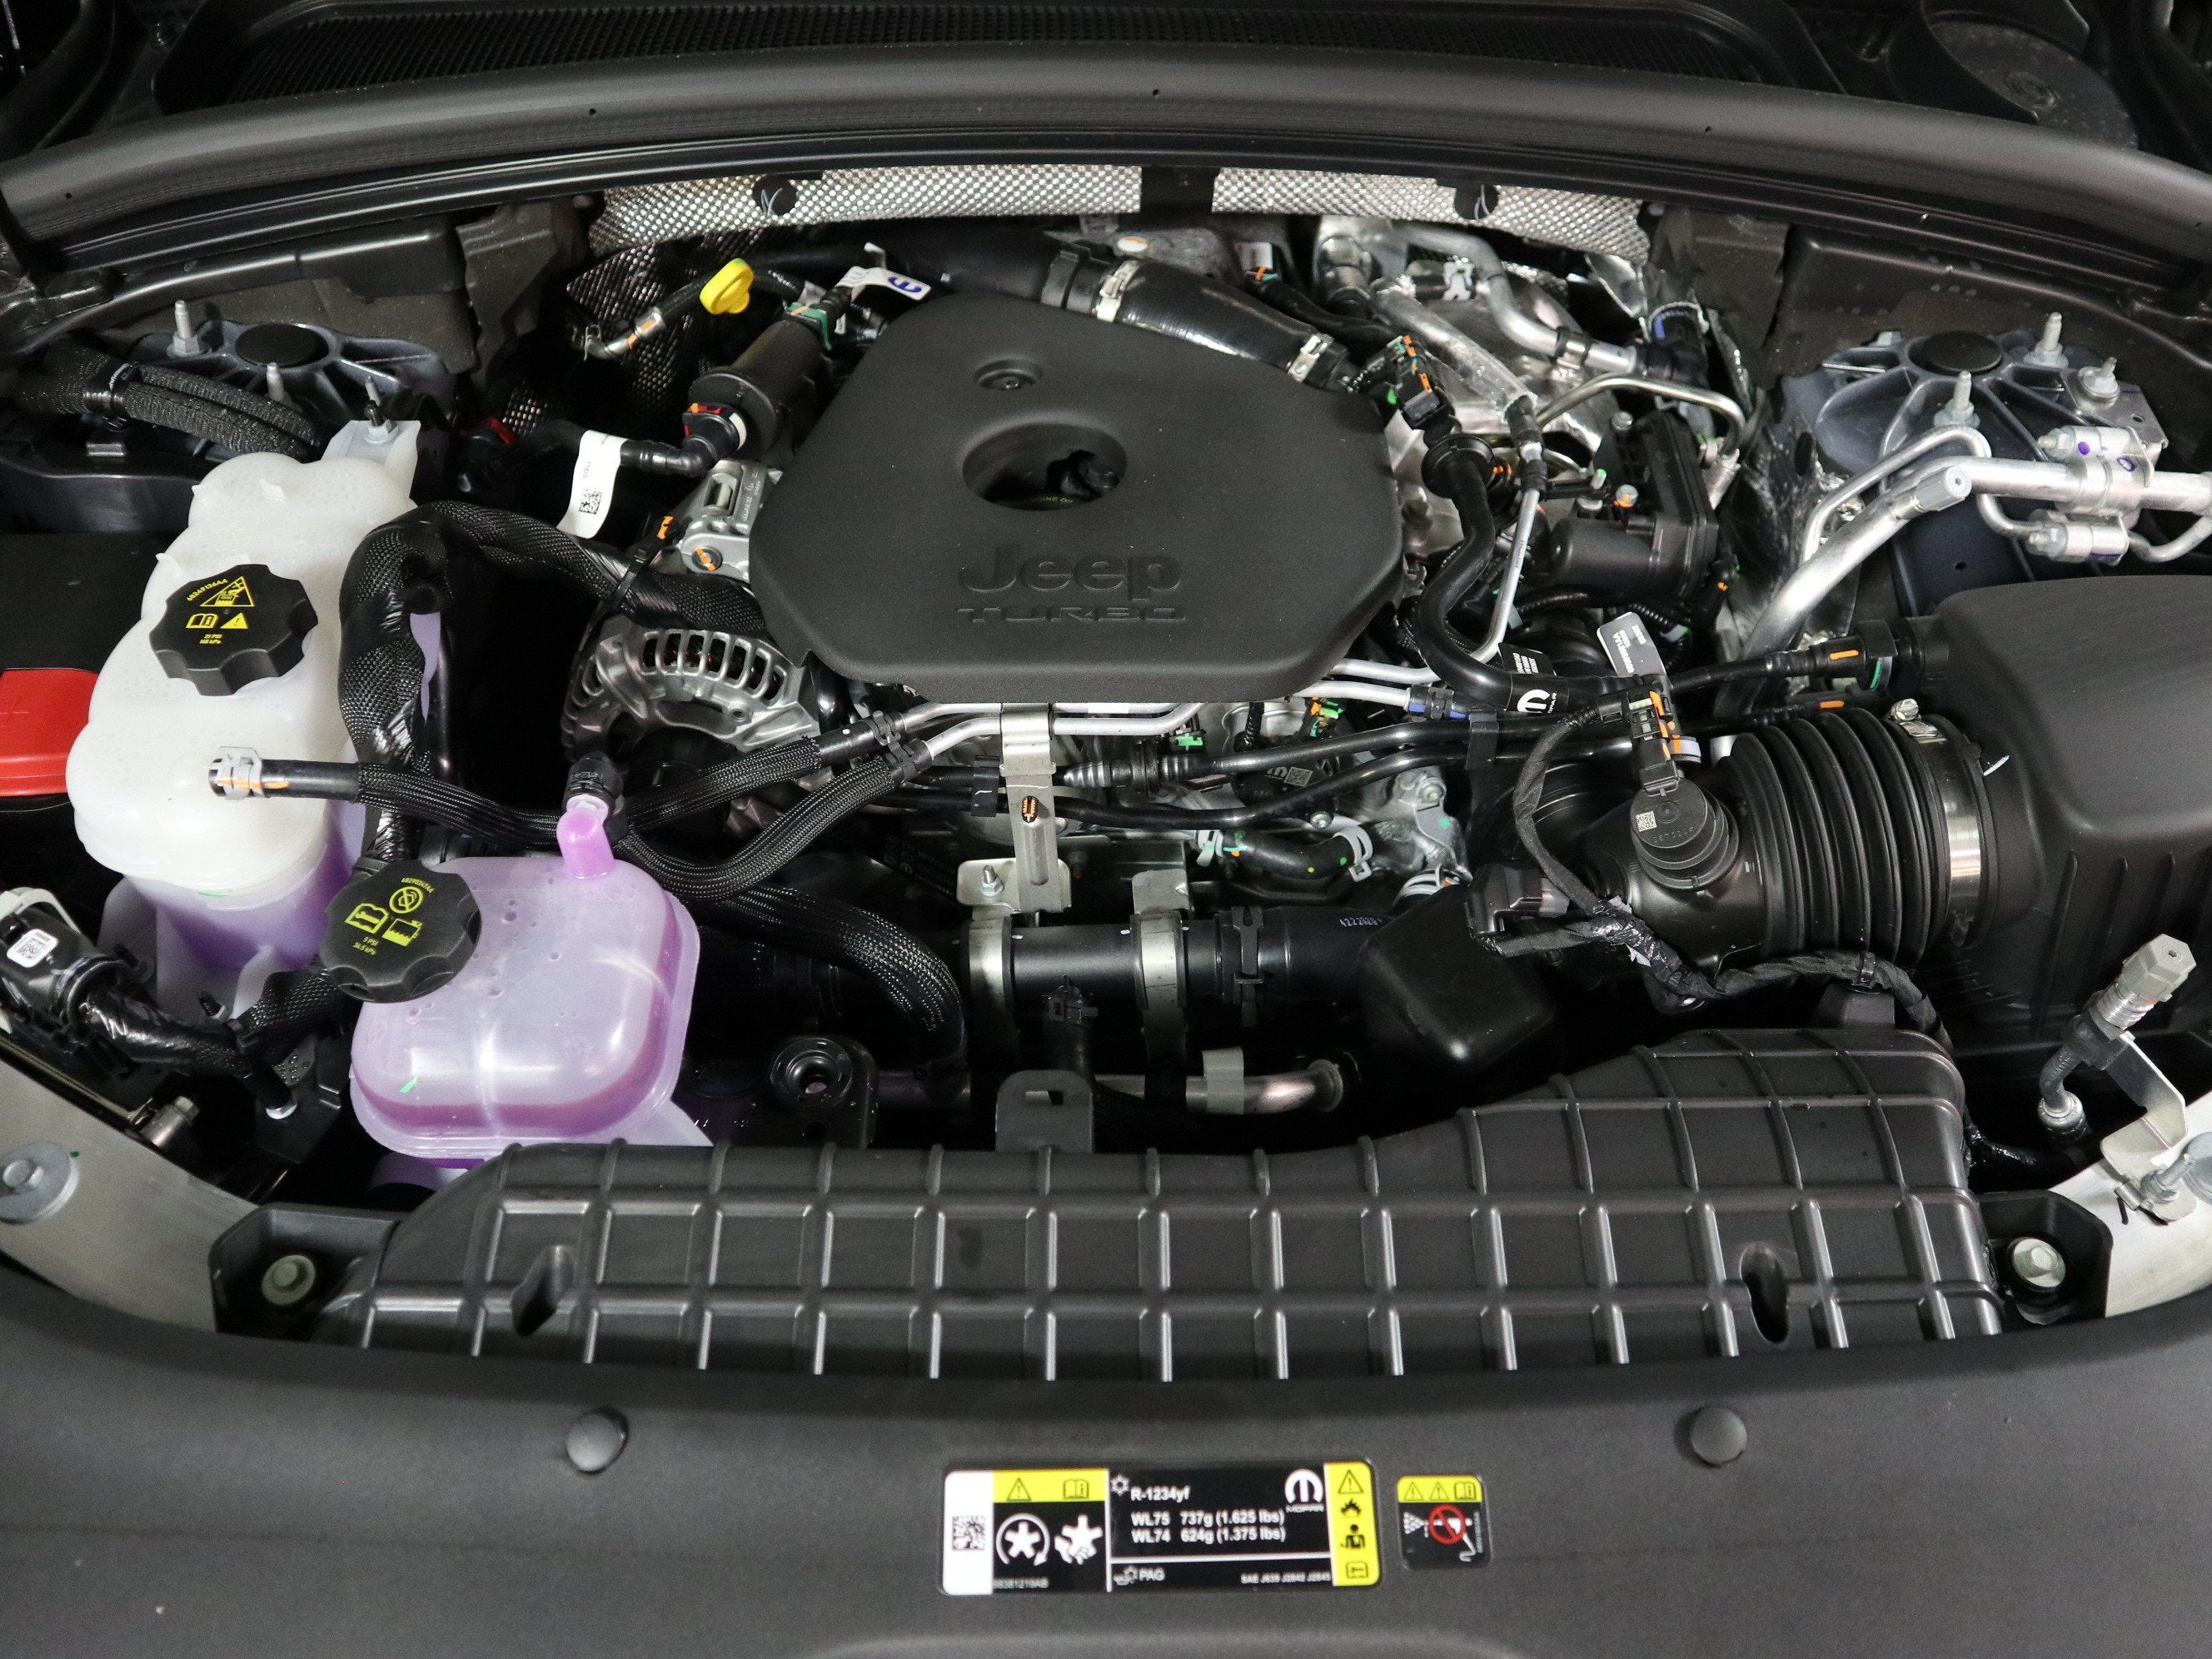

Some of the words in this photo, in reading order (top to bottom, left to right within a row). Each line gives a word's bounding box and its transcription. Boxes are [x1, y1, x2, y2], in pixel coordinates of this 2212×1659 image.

[959, 544, 1182, 601] Jeep
[957, 606, 1186, 623] TURBO
[1130, 1484, 1191, 1503] R-1234yf
[1130, 1511, 1171, 1527] WL75
[1179, 1510, 1213, 1527] 737g
[1216, 1509, 1257, 1527] (1.625
[1259, 1508, 1285, 1526] lbs)
[1131, 1527, 1172, 1543] WL74
[1180, 1527, 1214, 1544] 624g
[1216, 1526, 1258, 1544] (1.375
[1259, 1525, 1287, 1542] lbs)
[1138, 1567, 1165, 1582] PAG
